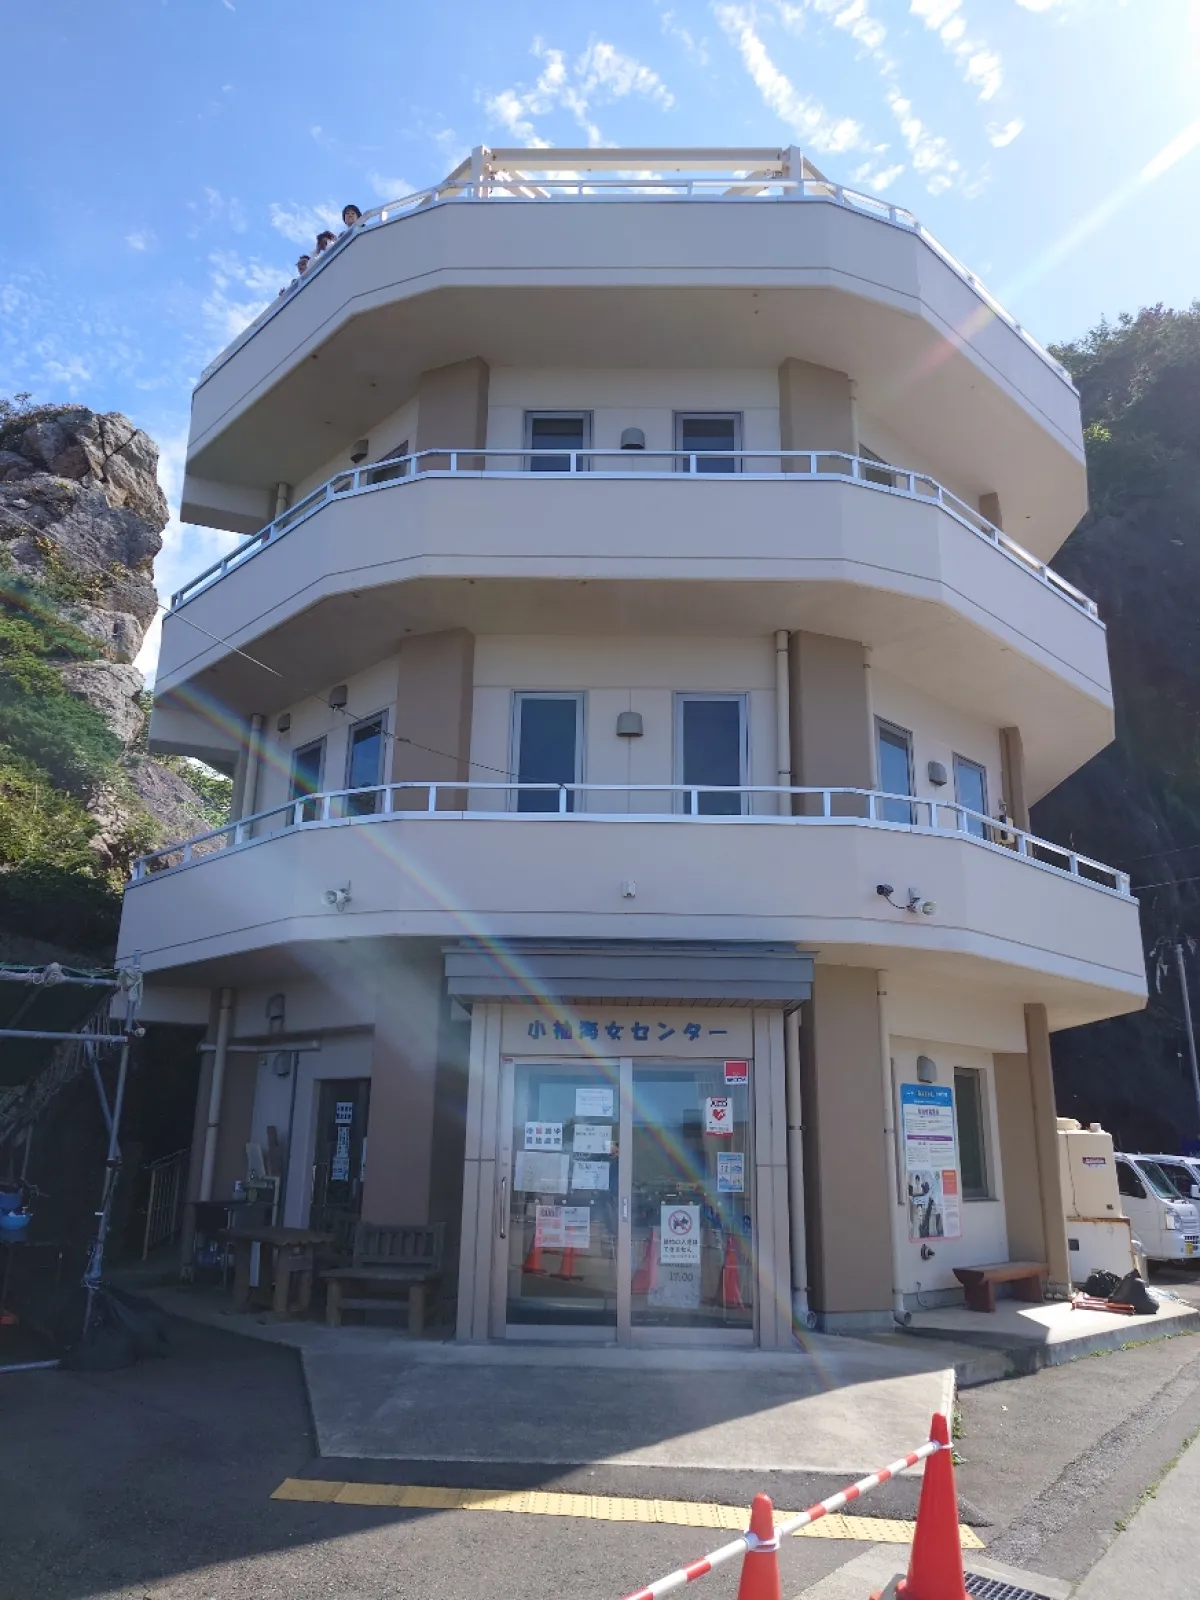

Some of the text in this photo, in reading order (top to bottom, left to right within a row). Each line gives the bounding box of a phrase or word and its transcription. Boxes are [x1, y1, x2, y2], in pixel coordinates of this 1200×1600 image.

[527, 1019, 728, 1041] 小袖海女センター
